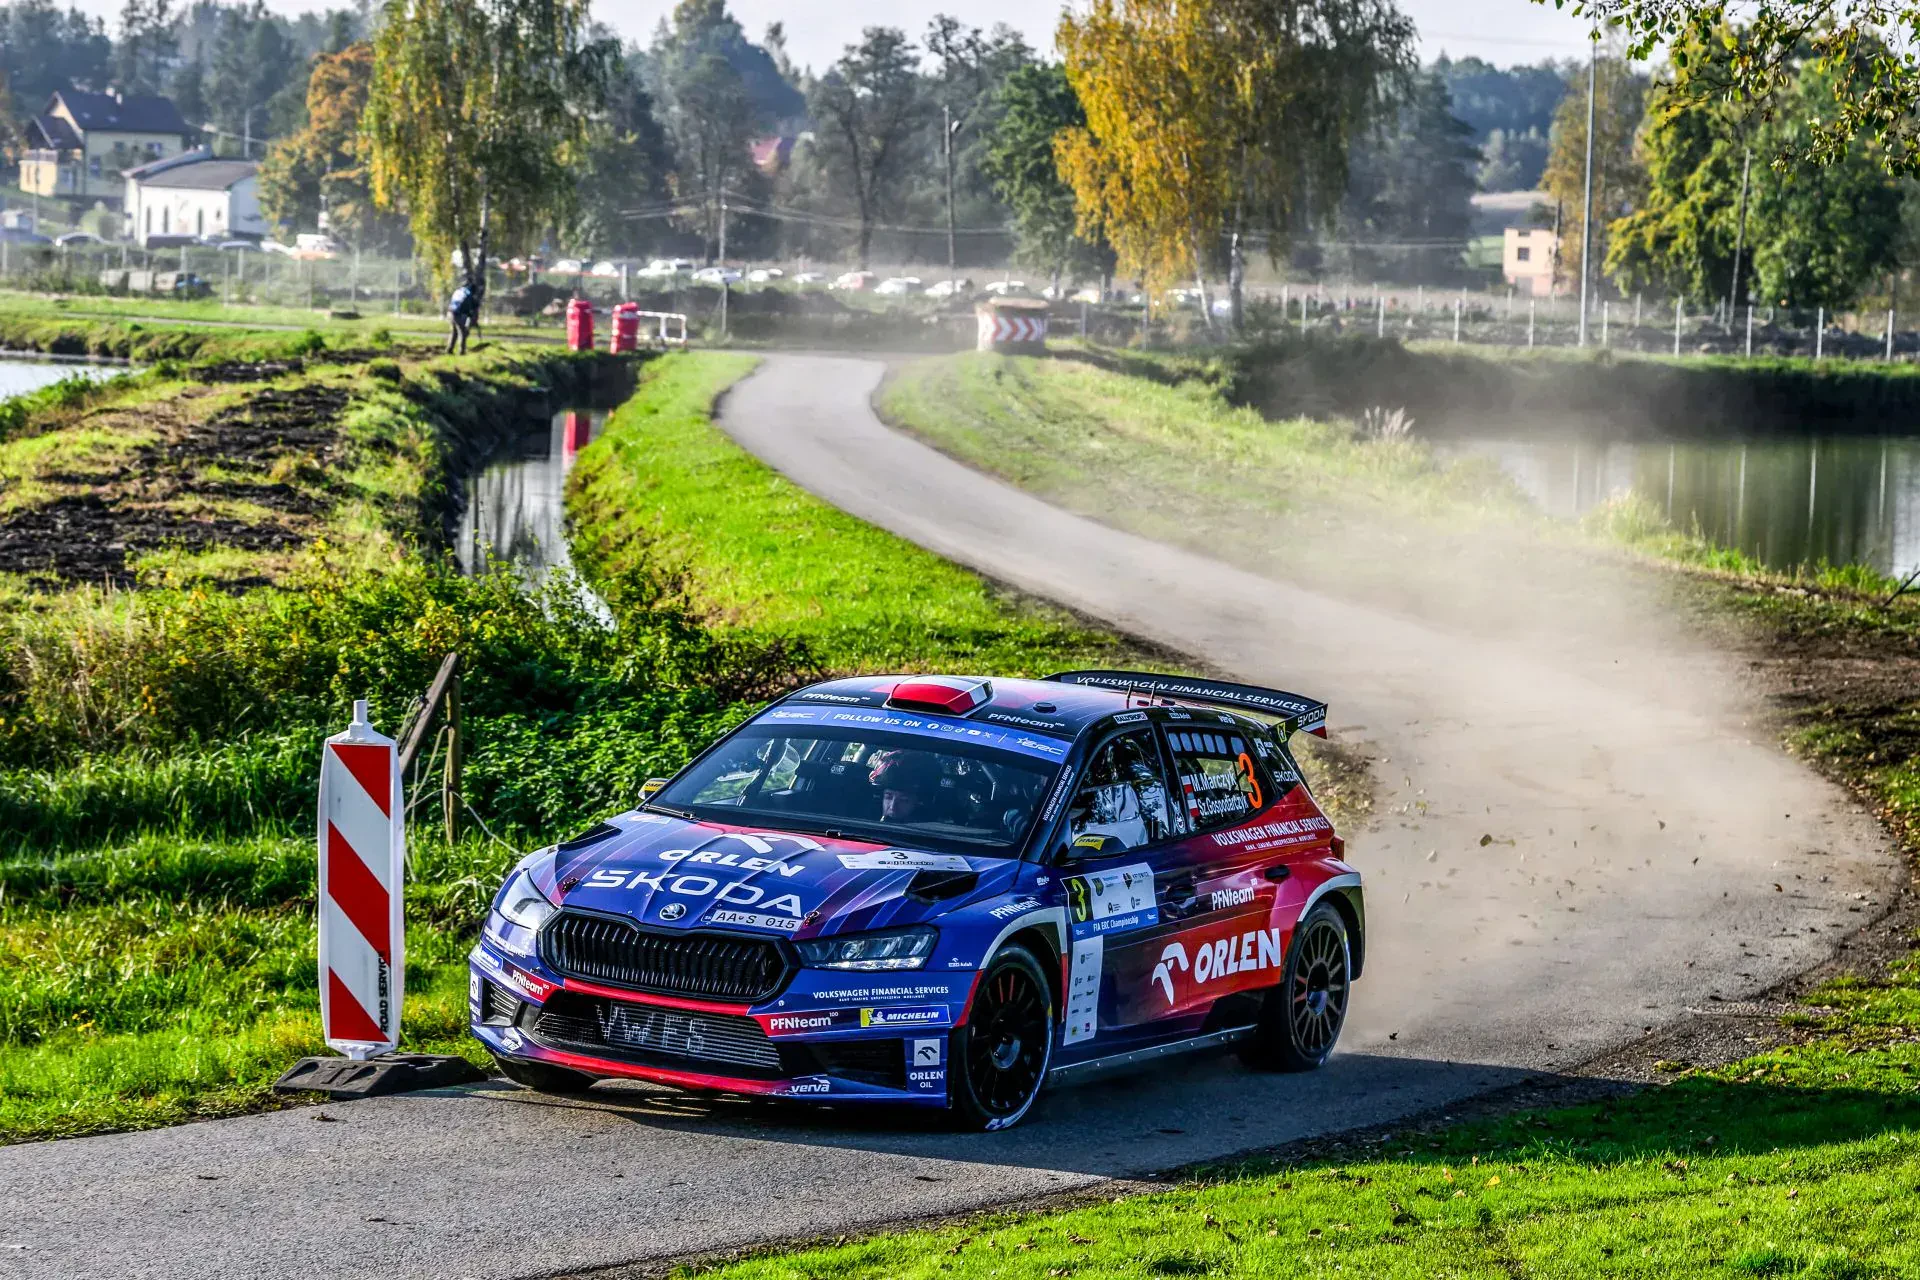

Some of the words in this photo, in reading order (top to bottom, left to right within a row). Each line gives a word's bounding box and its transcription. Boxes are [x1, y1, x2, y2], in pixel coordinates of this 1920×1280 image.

[1077, 676, 1168, 690] VOLKSWAGEN
[1170, 685, 1241, 700] FINANCIAL
[1243, 694, 1308, 712] SERVICES
[833, 712, 882, 725] FOLLOW
[883, 717, 901, 727] US
[903, 719, 921, 728] ON
[1190, 770, 1237, 792] M.Marczyk
[1238, 752, 1263, 809] 3
[1211, 827, 1267, 847] VOLKSWAGEN
[1264, 820, 1302, 838] FINANCIAL
[1300, 816, 1330, 832] SERVICES
[658, 848, 807, 878] ORLEN
[890, 851, 909, 860] 3
[1071, 878, 1086, 921] 3
[1211, 886, 1255, 911] PFNteam
[716, 911, 737, 922] AA
[746, 915, 757, 924] S
[766, 917, 796, 929] 015
[1093, 922, 1101, 932] FIA
[1101, 920, 1110, 930] ERC
[1111, 915, 1139, 928] Championship
[1194, 927, 1281, 984] ORLEN
[813, 989, 869, 999] VOLKSWAGEN
[871, 987, 914, 997] FINANCIAL
[914, 986, 949, 995] SERVICES
[379, 1000, 389, 1033] ROAD
[770, 1016, 832, 1030] PFNteam
[887, 1011, 940, 1021] MICHELIN
[909, 1071, 944, 1081] ORLEN
[791, 1082, 831, 1093] verva
